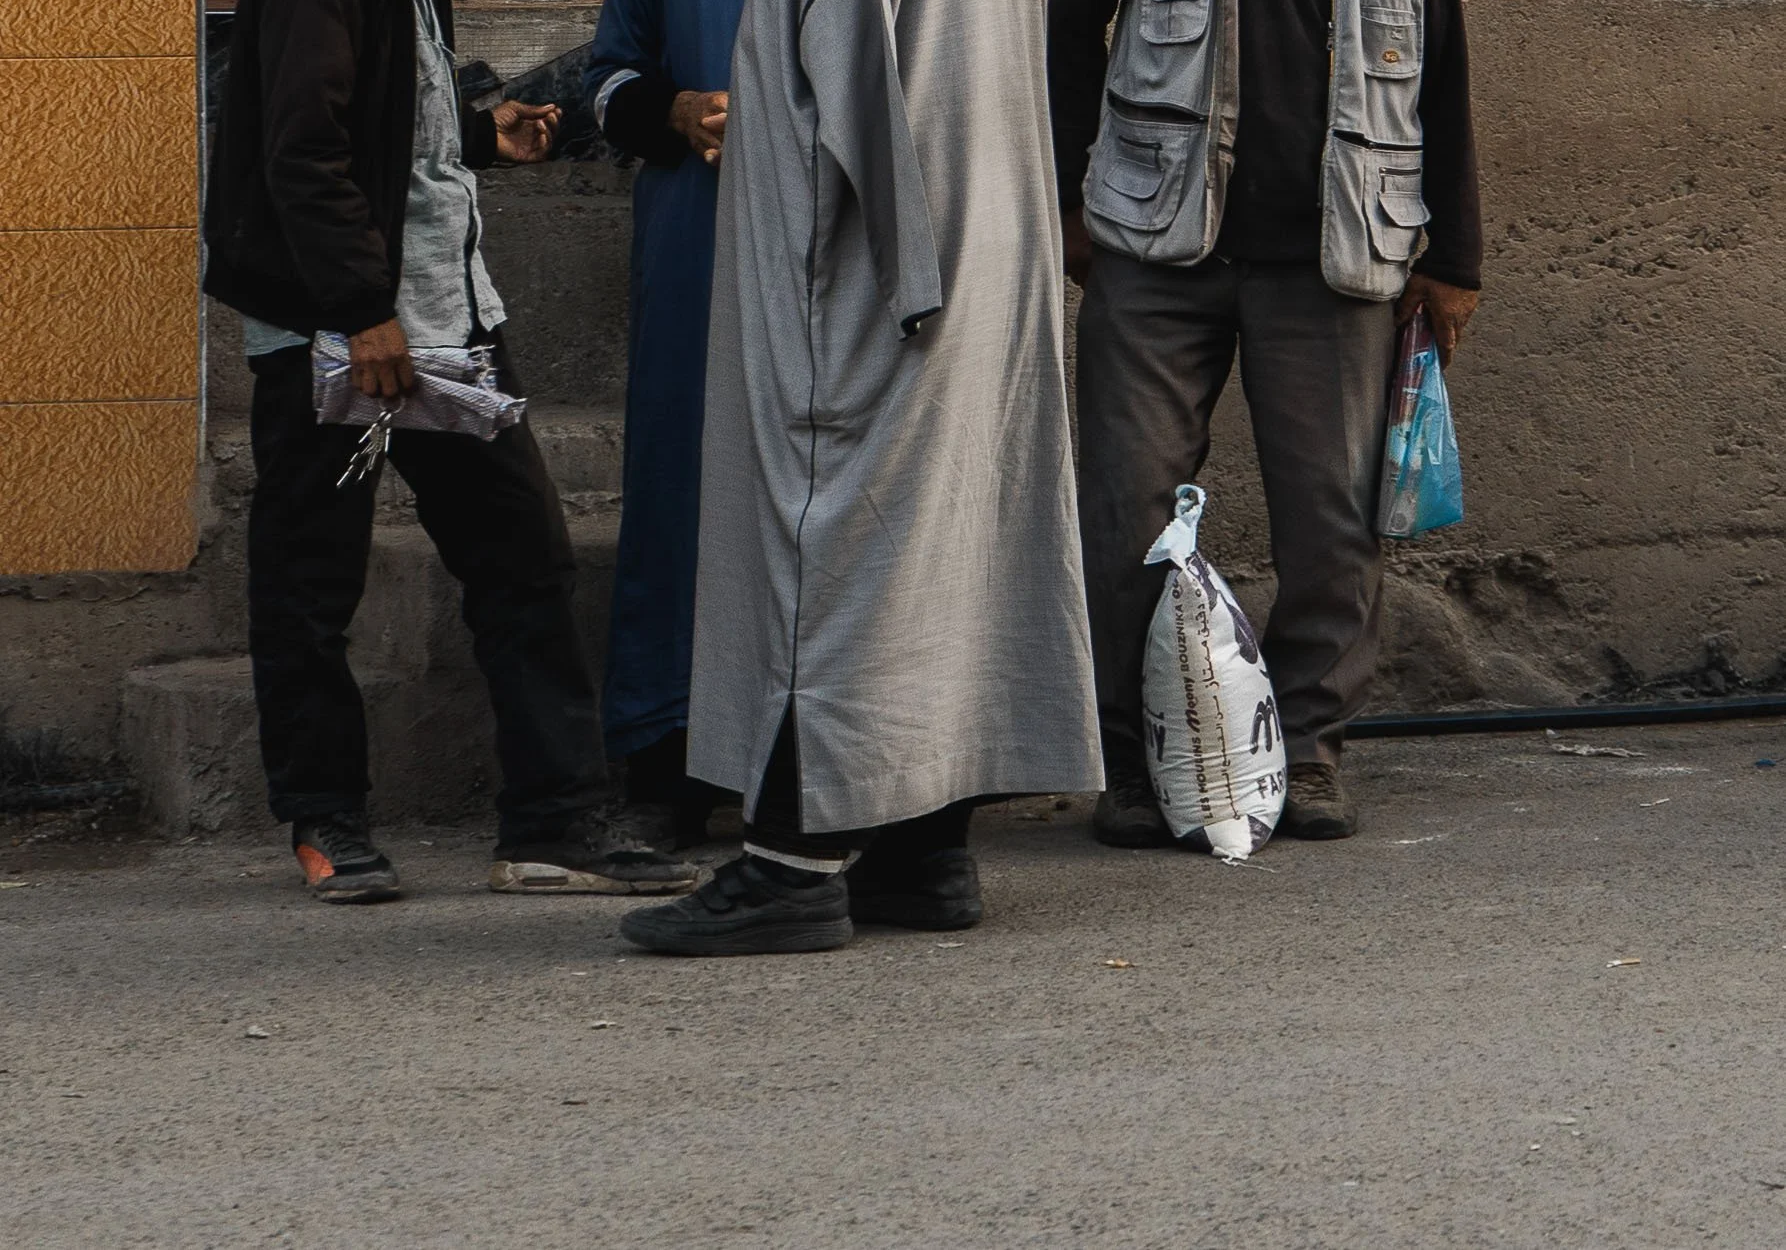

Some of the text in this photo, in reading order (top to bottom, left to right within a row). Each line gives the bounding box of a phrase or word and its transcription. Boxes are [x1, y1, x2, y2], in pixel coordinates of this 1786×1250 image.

[1175, 604, 1189, 672] BOUZNIKA
[1196, 603, 1210, 637] دقيق
[1201, 640, 1219, 688] ممتاز
[1192, 737, 1208, 793] MOULINS
[1200, 797, 1214, 819] LES
